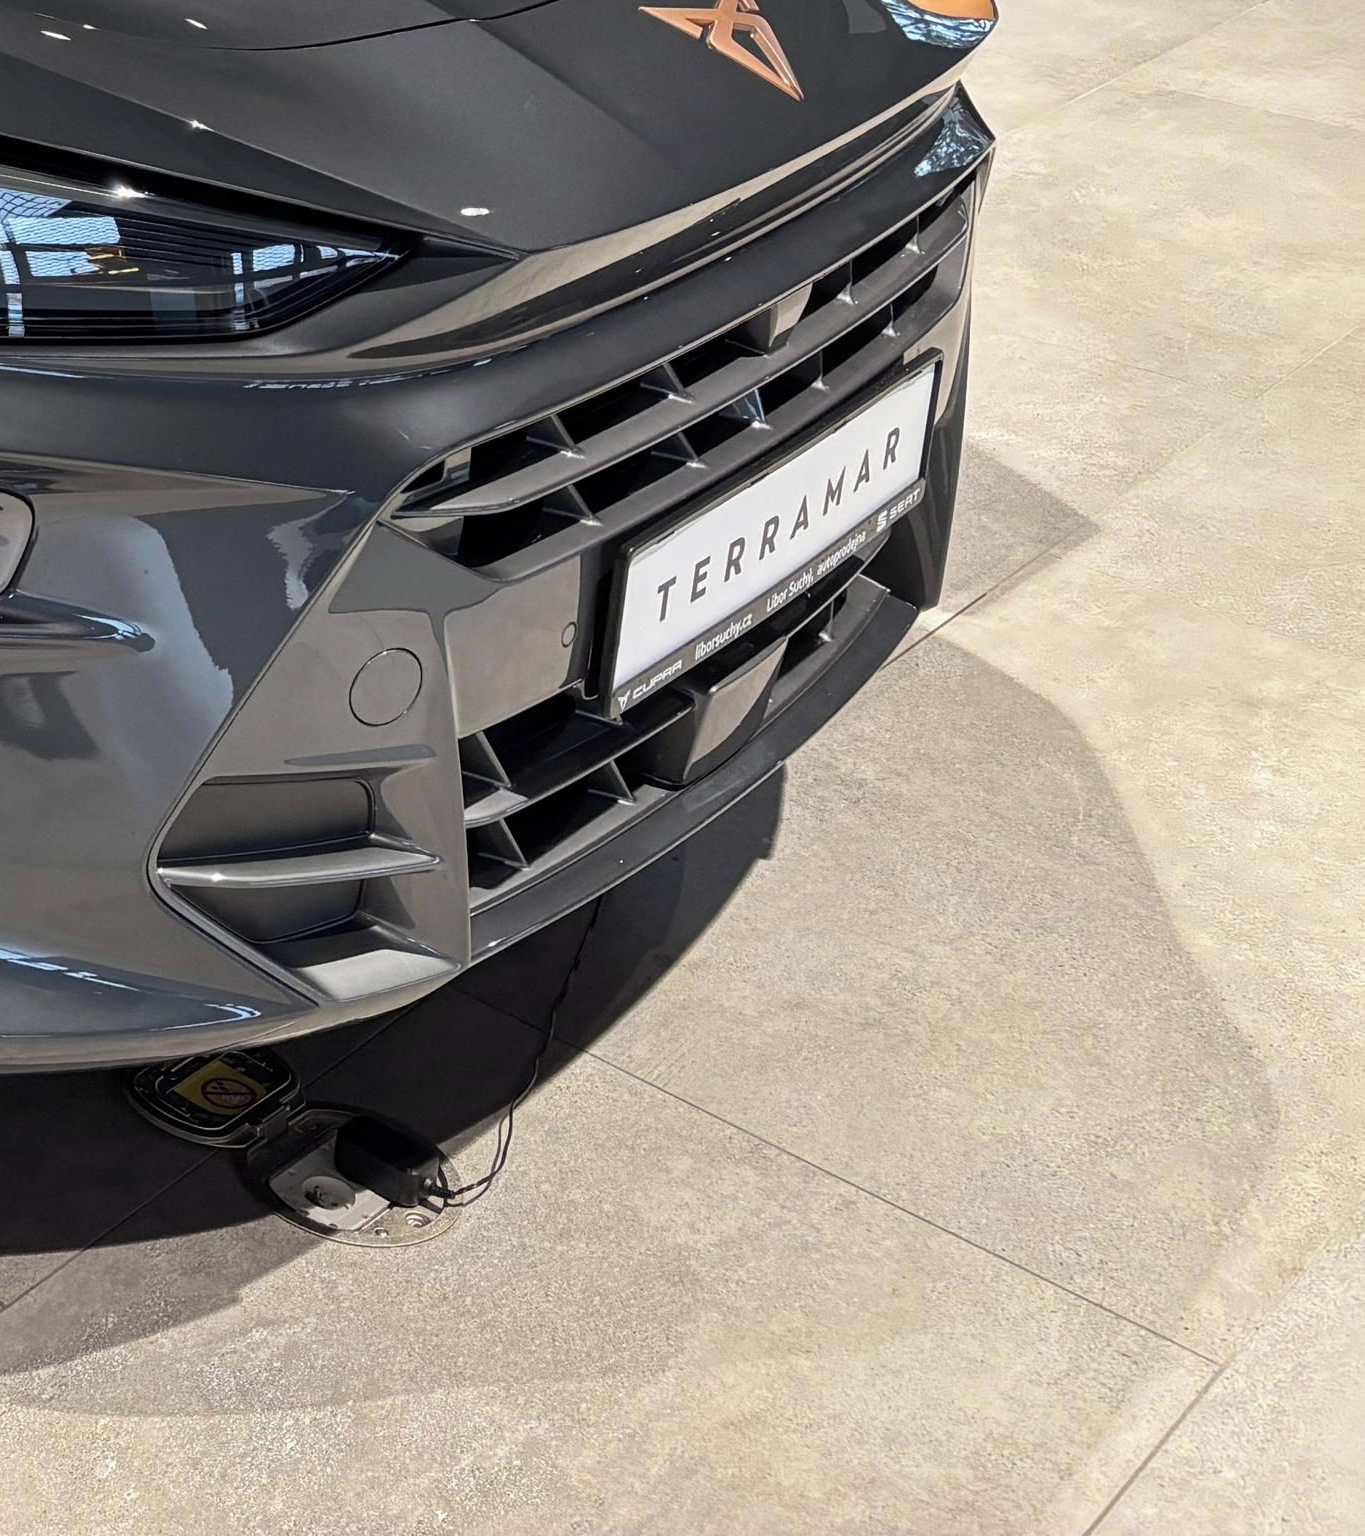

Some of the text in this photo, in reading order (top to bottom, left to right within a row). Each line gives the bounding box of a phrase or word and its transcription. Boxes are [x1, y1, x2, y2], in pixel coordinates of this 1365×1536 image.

[656, 426, 901, 623] TERRAMAR
[888, 488, 921, 520] SEAT
[766, 587, 789, 613] Libor
[694, 613, 753, 661] liborsuchy.cz
[632, 659, 683, 700] CUPRA
